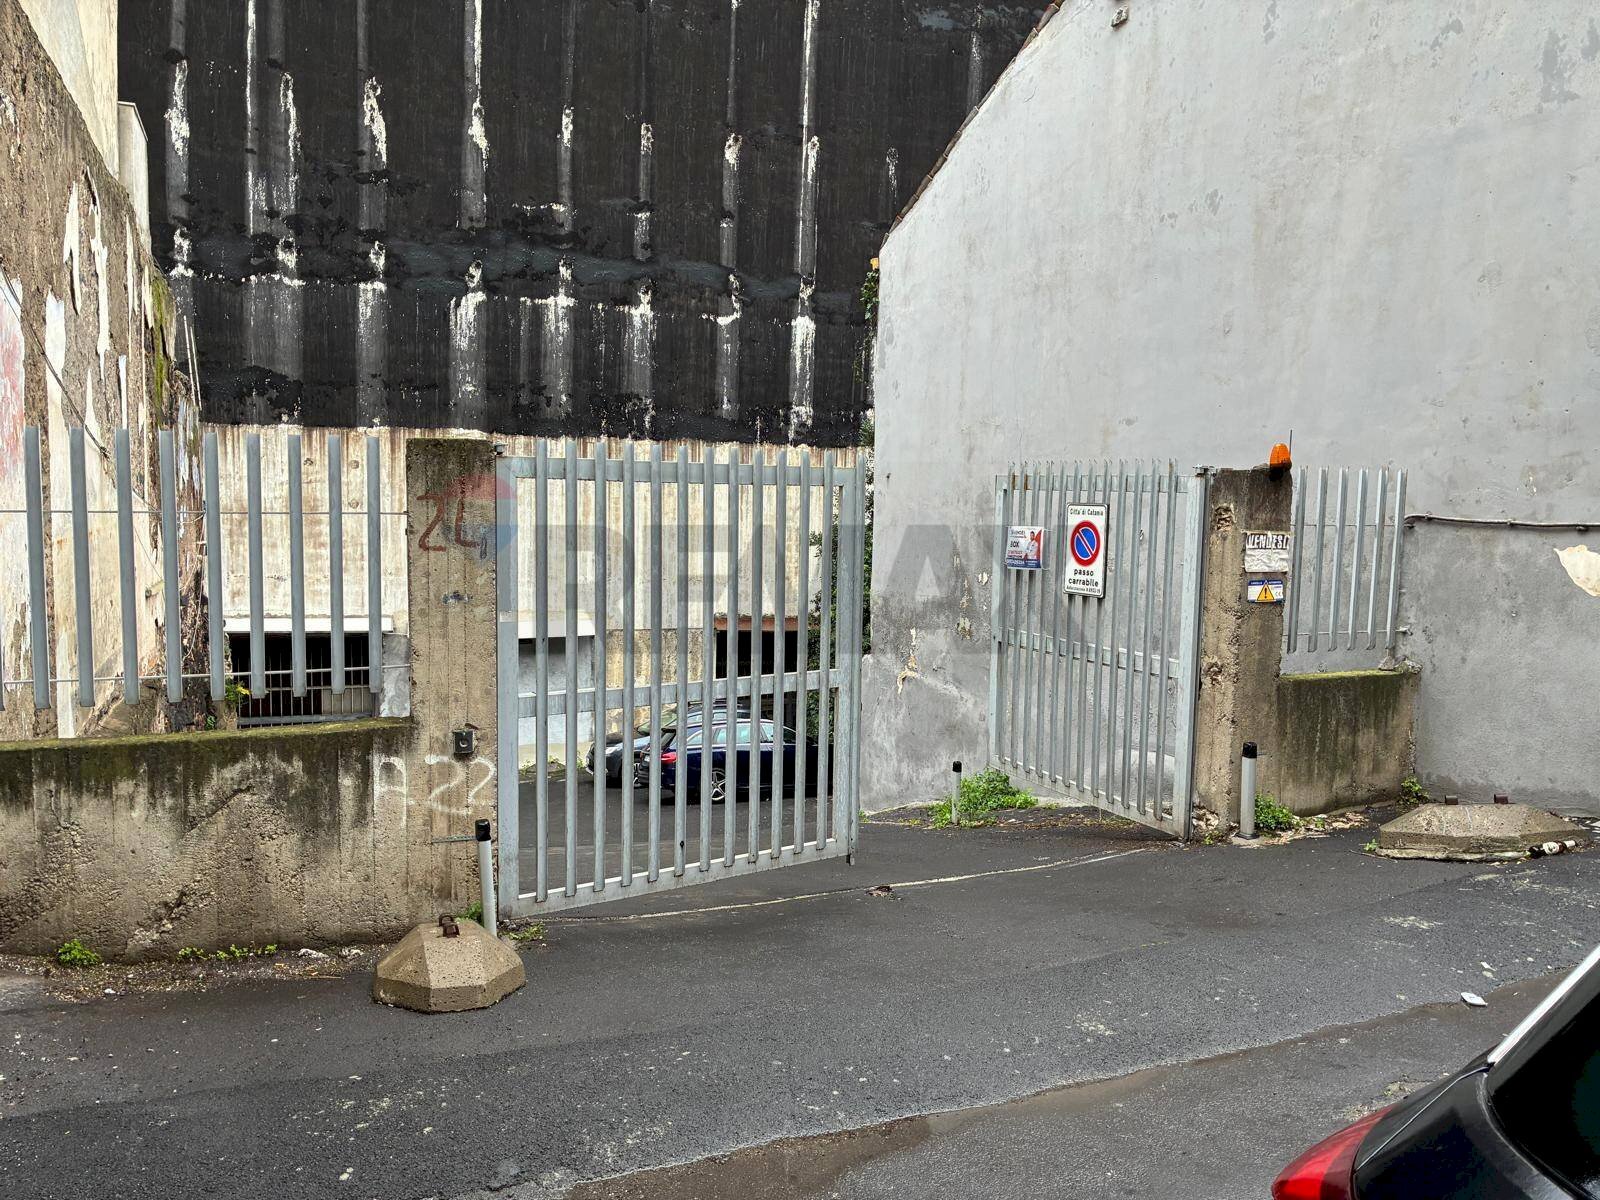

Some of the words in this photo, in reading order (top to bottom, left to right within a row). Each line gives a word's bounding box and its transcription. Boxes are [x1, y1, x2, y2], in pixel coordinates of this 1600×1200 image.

[1247, 533, 1289, 550] VENDESI
[1074, 568, 1094, 577] passo
[1068, 578, 1099, 587] carrabile
